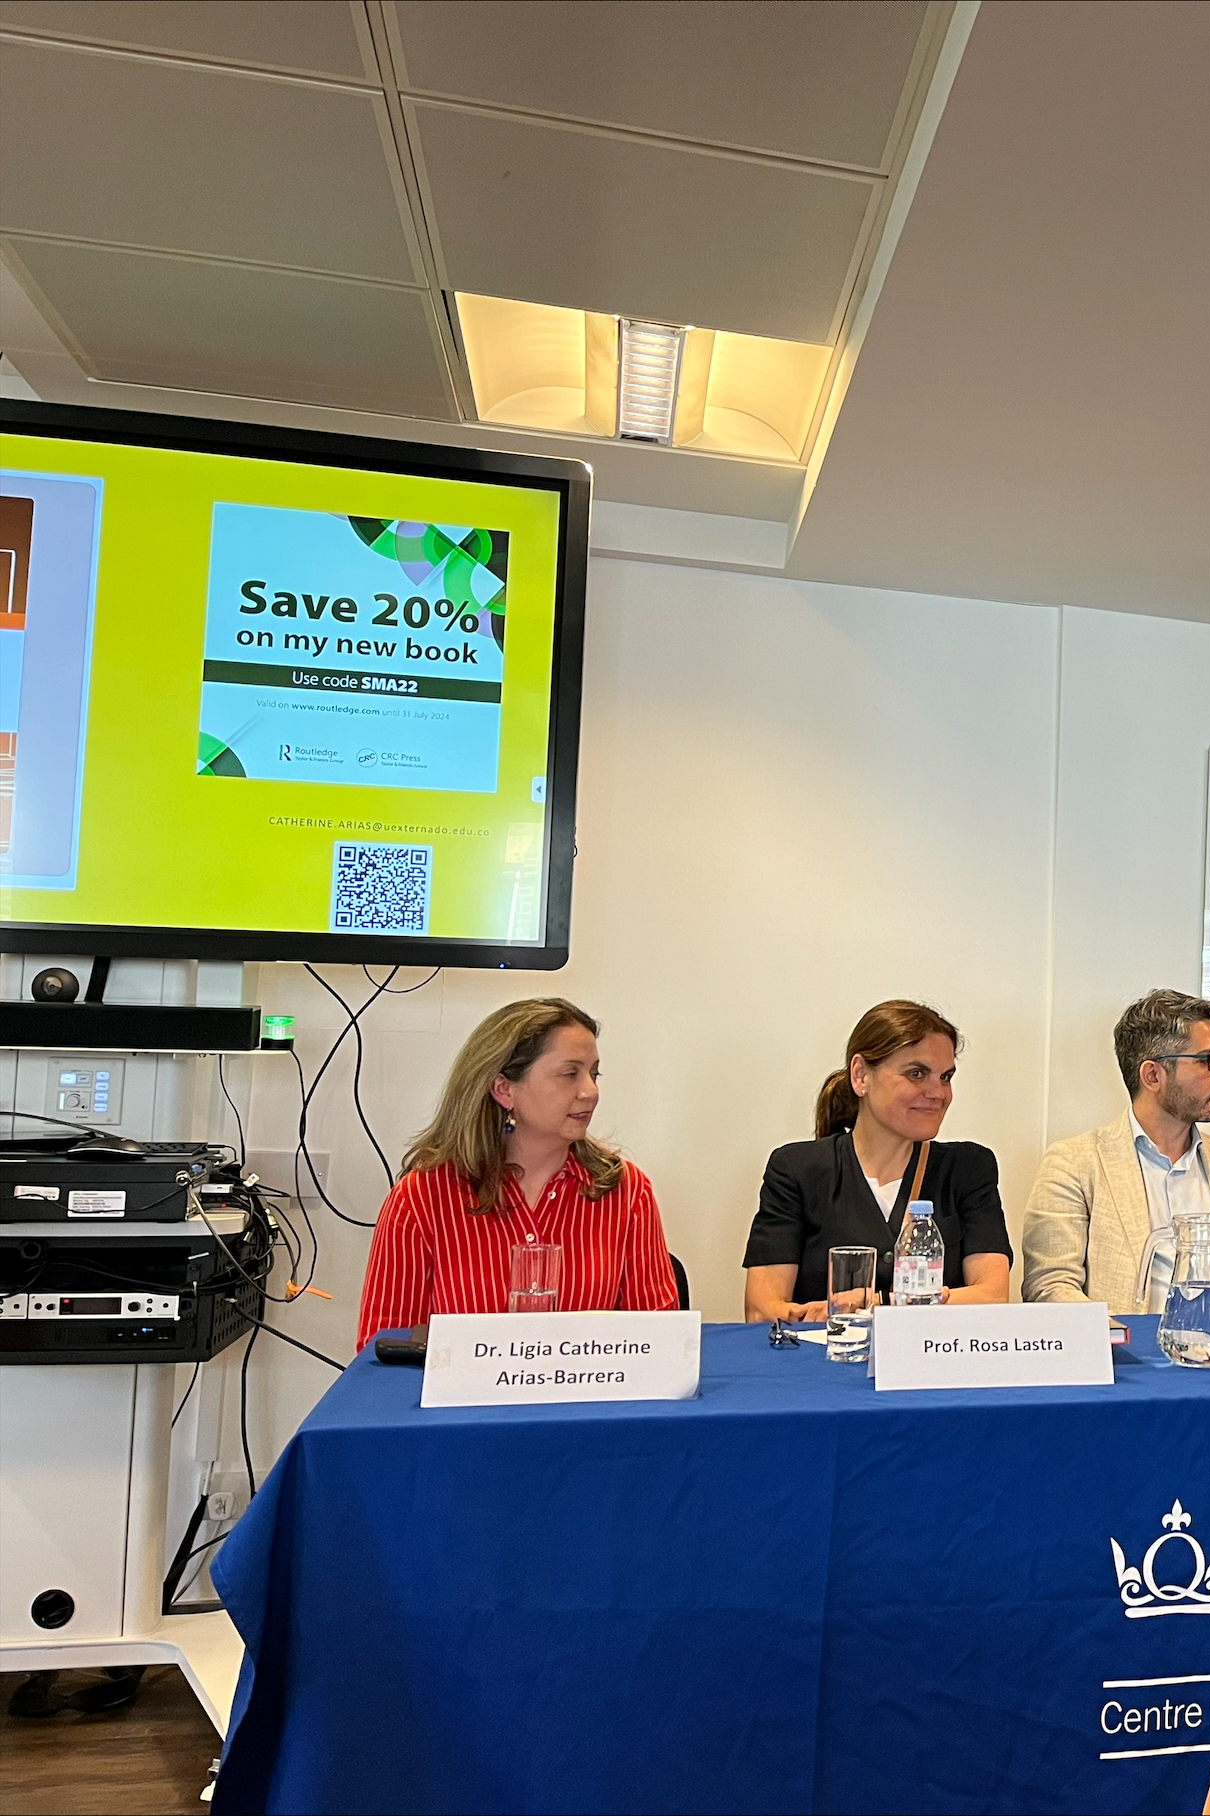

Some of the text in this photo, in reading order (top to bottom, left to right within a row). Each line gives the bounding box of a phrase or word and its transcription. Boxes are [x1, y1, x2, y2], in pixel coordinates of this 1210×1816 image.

[239, 580, 480, 633] Save 20%
[236, 630, 479, 664] on my new book
[292, 670, 418, 693] Use code SMA22
[256, 699, 450, 721] Valid on www.routledge.com until 31 July 2024
[295, 746, 339, 758] Routledge
[381, 752, 421, 763] CRC Press
[269, 816, 490, 837] CATHERINE.ARIAS@uexternado.edu.co
[474, 1340, 651, 1360] Dr. Ligia Catherine
[924, 1338, 1063, 1353] Prof. Rosa Lastra
[495, 1369, 625, 1386] Arias-Barrera
[1100, 1697, 1203, 1735] Centre
